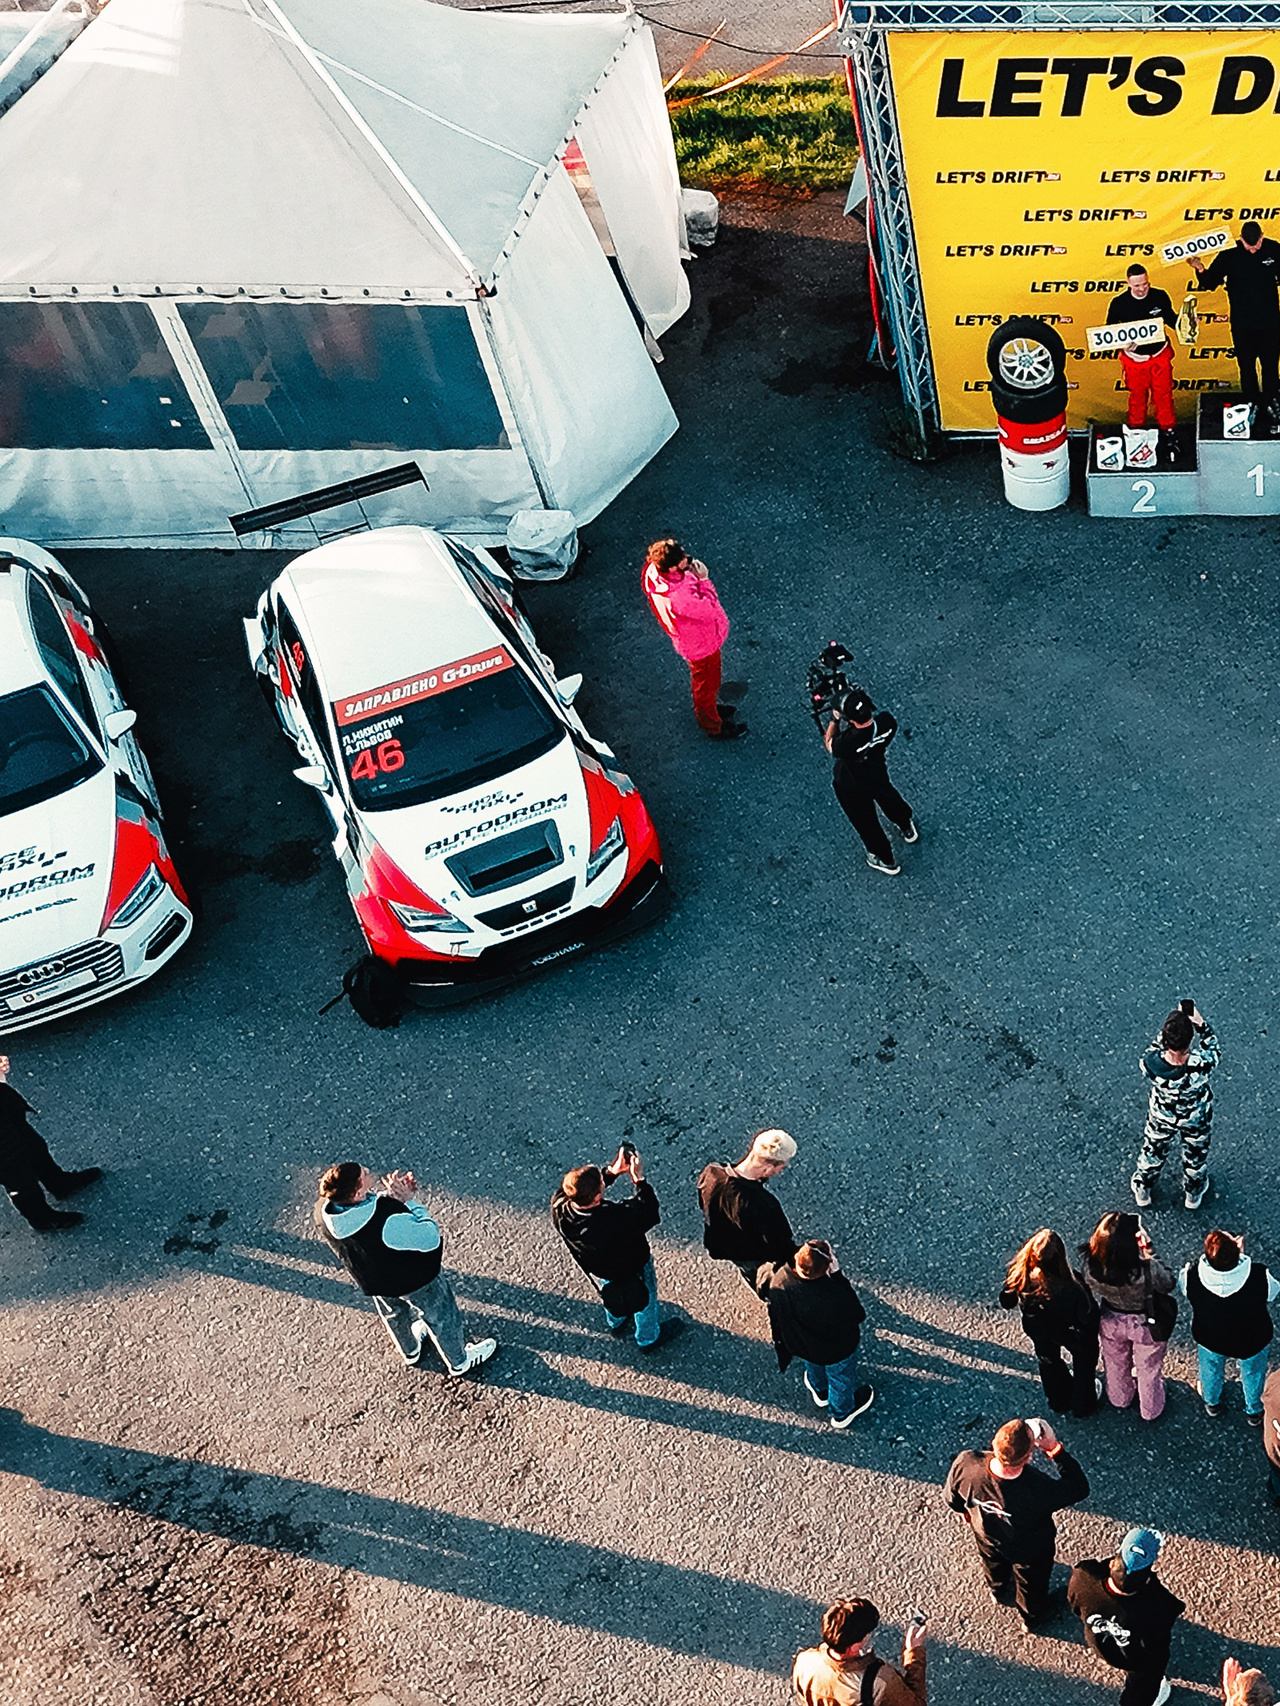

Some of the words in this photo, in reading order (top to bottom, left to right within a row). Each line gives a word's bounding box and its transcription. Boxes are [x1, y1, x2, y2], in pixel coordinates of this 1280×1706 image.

[935, 55, 1187, 118] LET'S
[936, 171, 986, 184] LET'S
[992, 171, 1047, 183] DRIFT
[1100, 170, 1151, 183] LET'S
[1156, 170, 1212, 182] DRIFT
[1024, 209, 1073, 221] LET'S
[1078, 209, 1133, 221] DRIFT
[1184, 208, 1234, 220] LET'S
[945, 245, 994, 257] LET'S
[1000, 244, 1053, 256] DRIFT
[1105, 244, 1154, 256] LET'S
[1031, 281, 1079, 293] LET'S
[1084, 280, 1128, 292] DRIF
[955, 315, 1002, 326] LET'S
[1247, 464, 1265, 496] 1
[1131, 480, 1157, 513] 2
[344, 675, 438, 718] ЗАПРАВЛЕНО
[351, 738, 406, 781] 46
[425, 793, 568, 855] AUTODROM
